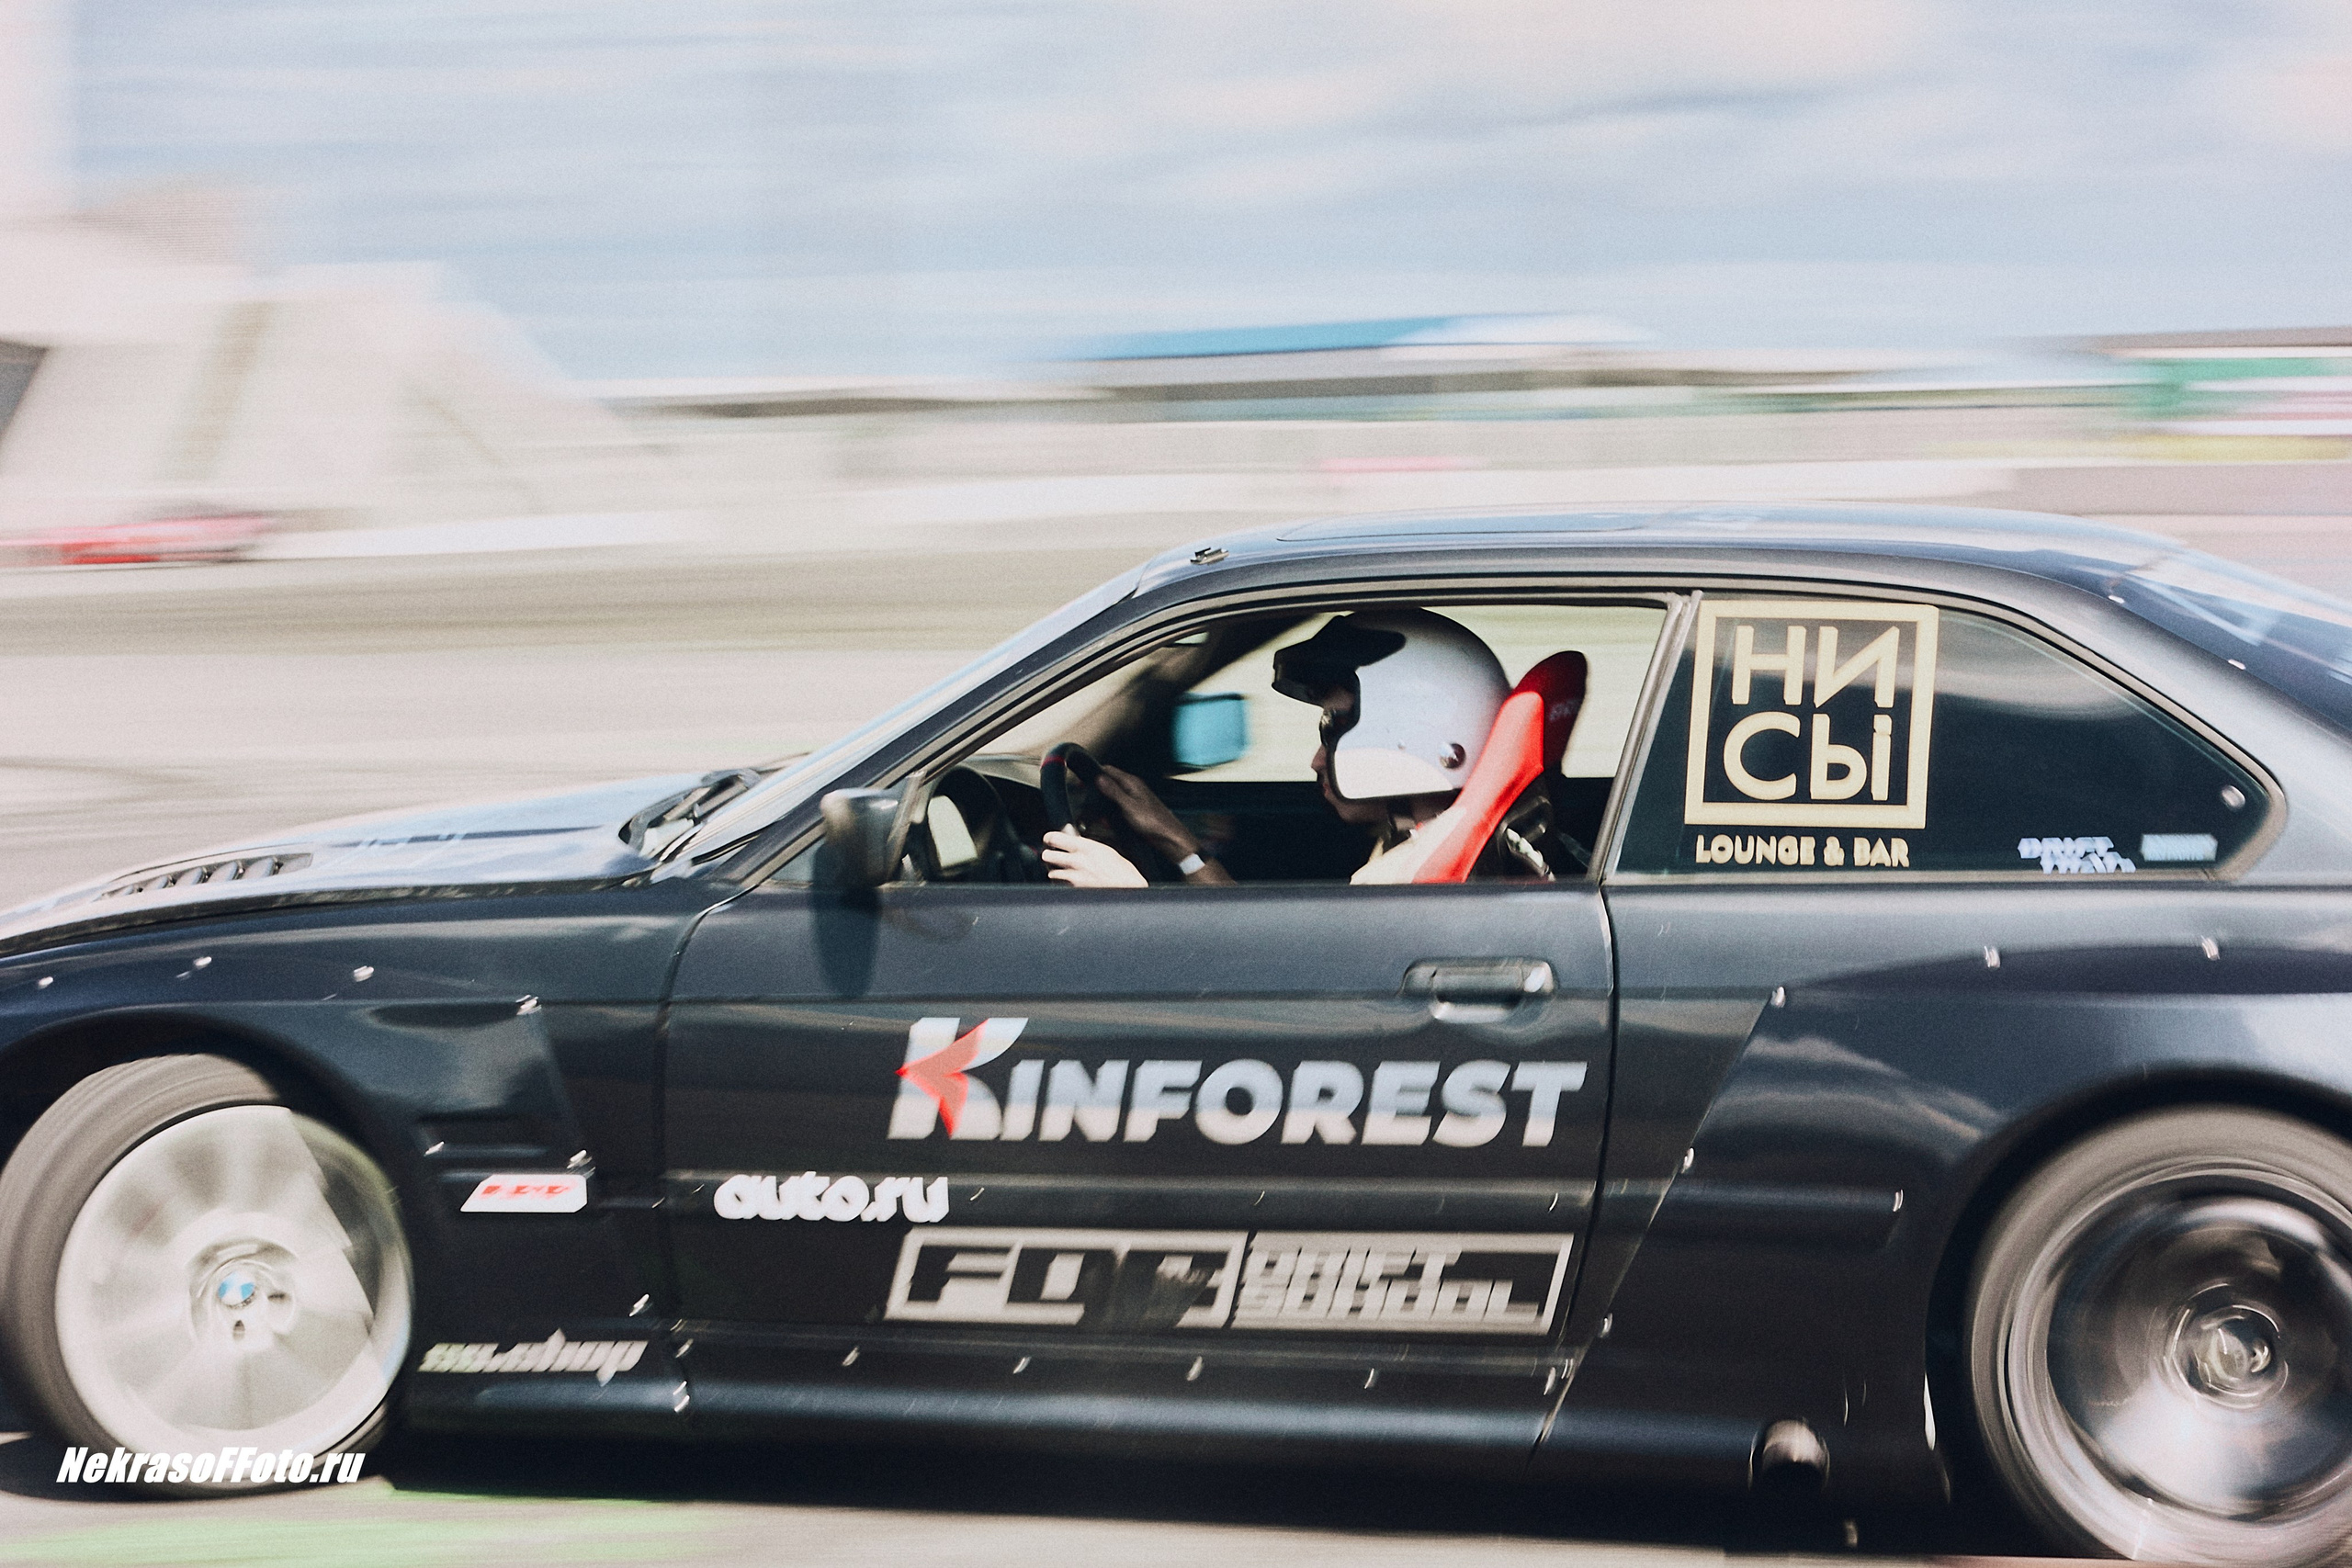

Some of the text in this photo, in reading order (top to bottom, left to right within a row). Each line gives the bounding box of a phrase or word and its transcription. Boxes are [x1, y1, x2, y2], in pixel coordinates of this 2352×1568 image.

[1731, 625, 1900, 708] НИ
[1695, 833, 1910, 868] LOUNGE & BAR
[887, 1016, 1589, 1147] KINFOREST
